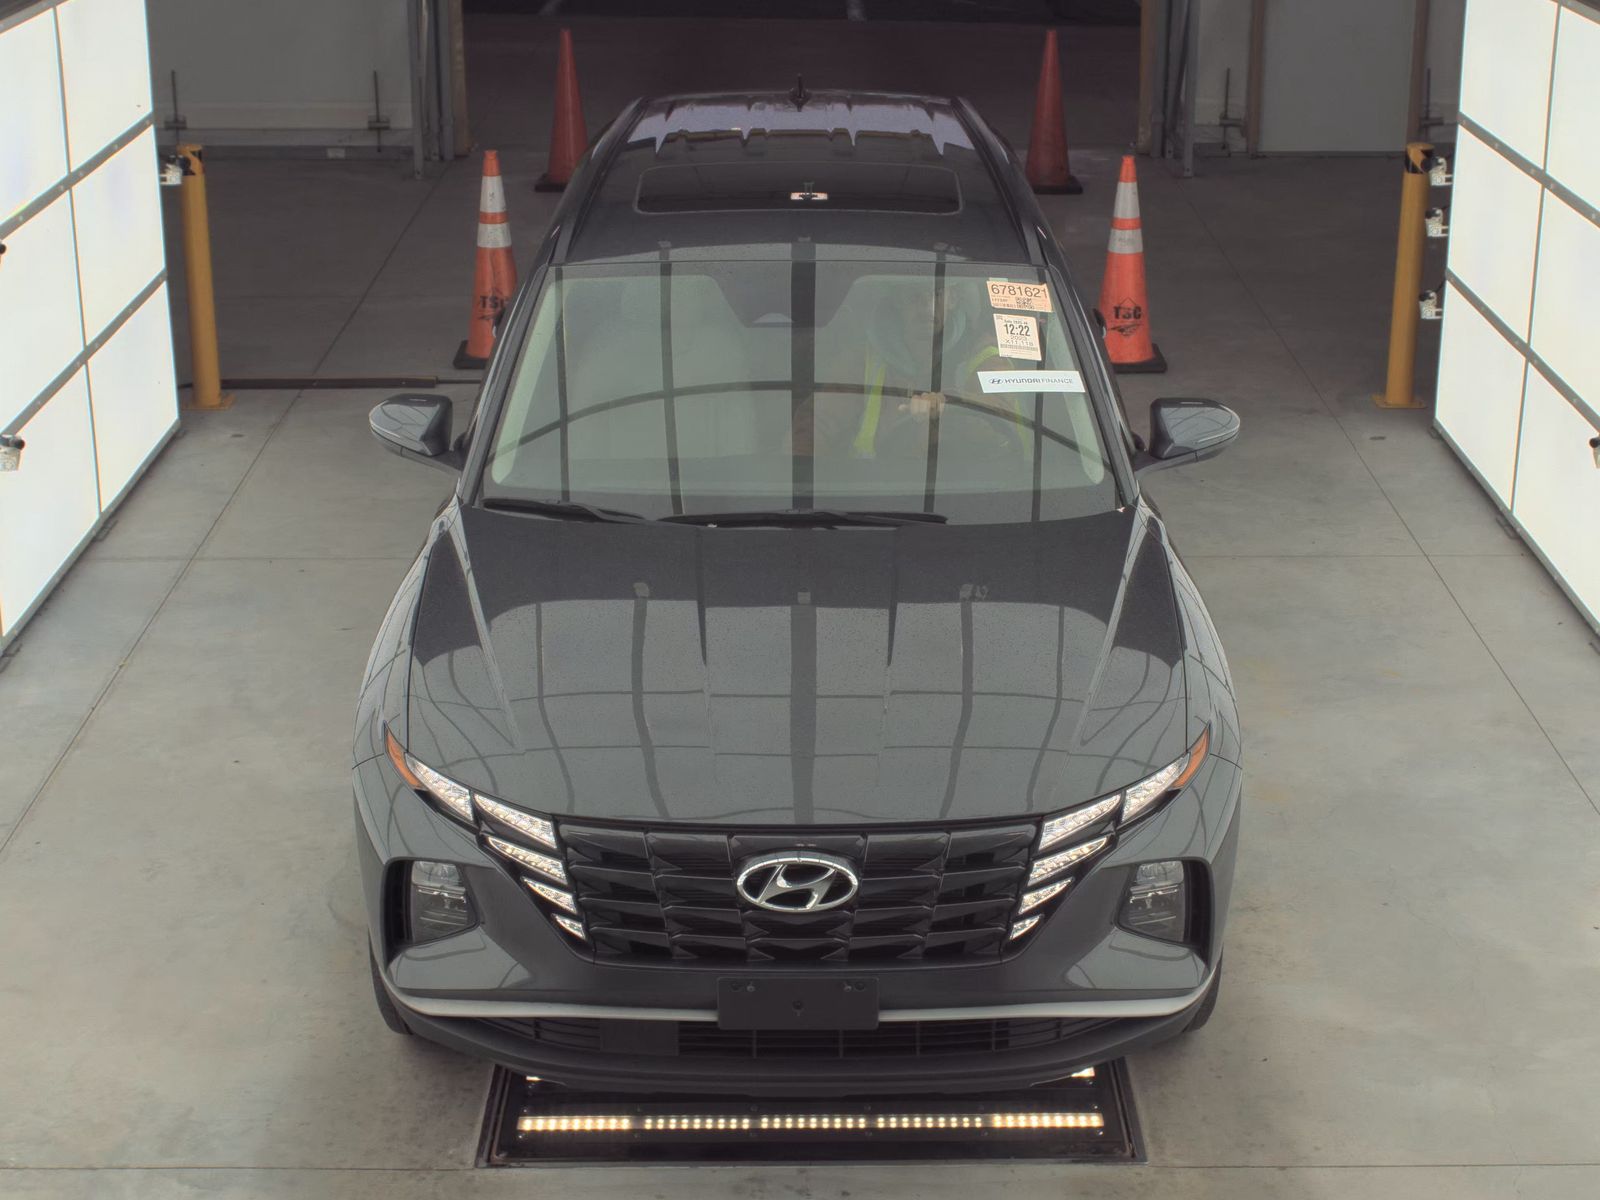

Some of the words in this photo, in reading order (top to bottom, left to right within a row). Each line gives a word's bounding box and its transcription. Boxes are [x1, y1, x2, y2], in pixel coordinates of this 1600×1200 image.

[991, 284, 1047, 298] 6781621
[1113, 305, 1142, 319] TSC
[1004, 323, 1031, 337] 12:22
